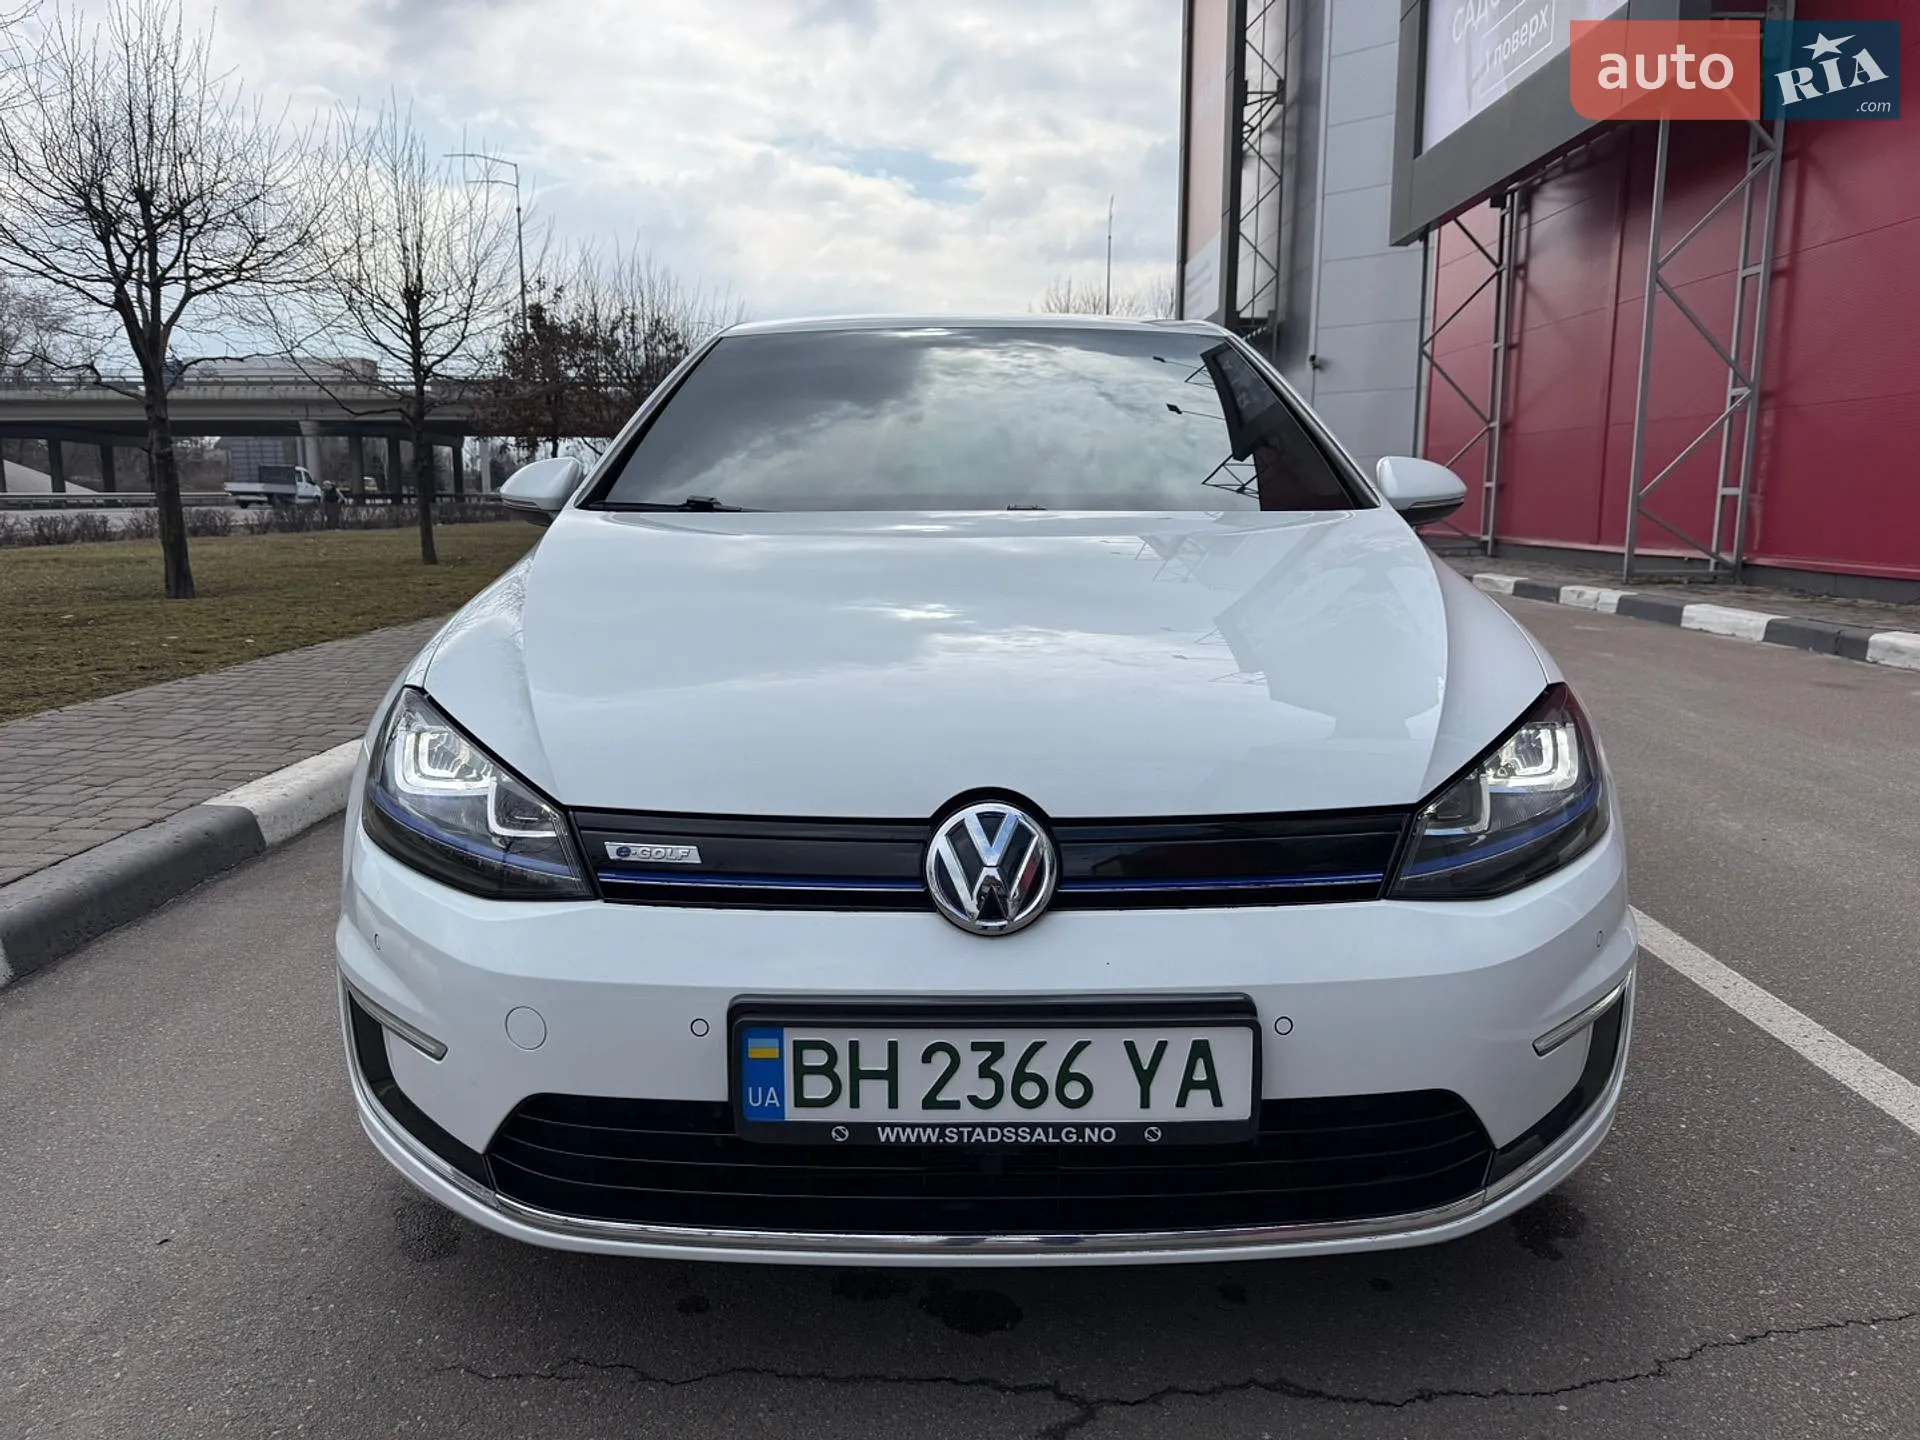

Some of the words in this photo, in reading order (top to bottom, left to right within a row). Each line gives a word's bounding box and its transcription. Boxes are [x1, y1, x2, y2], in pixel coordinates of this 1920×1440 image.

[1493, 4, 1549, 69] поверх
[792, 1039, 899, 1110] BH
[921, 1039, 1093, 1110] 2366
[1124, 1039, 1223, 1109] YA
[748, 1087, 780, 1108] UA
[877, 1126, 1117, 1143] WWW.STADSSALG.NO
